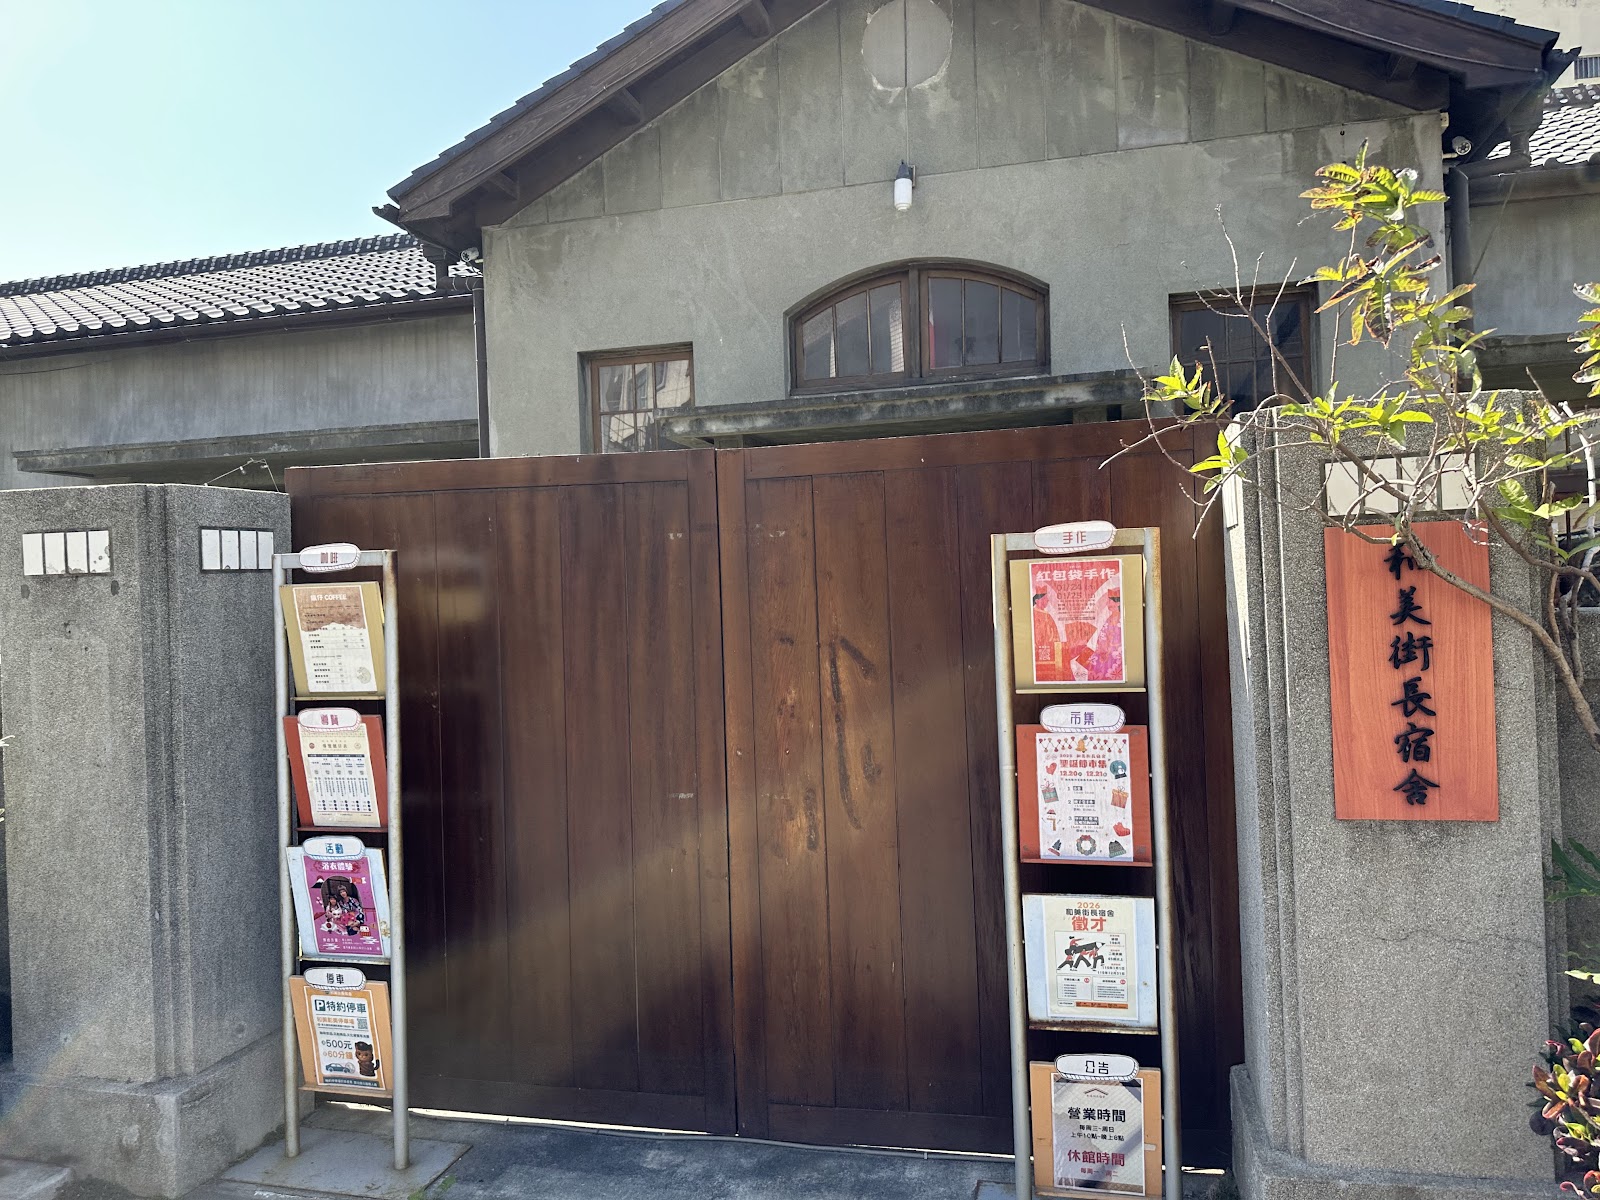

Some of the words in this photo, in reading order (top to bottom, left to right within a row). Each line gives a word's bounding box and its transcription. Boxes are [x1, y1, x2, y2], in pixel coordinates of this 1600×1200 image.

[1062, 530, 1087, 545] 手作
[1036, 567, 1116, 582] 紅包袋手作
[1070, 711, 1095, 726] 市集
[325, 842, 344, 855] 活動
[321, 861, 353, 871] 浴衣體驗
[1066, 908, 1115, 917] 和美街長宿舍
[1077, 901, 1101, 909] 2026
[1071, 915, 1107, 932] 徵才
[326, 972, 345, 985] 停車
[326, 1000, 367, 1013] 特約停車
[1085, 1060, 1109, 1075] 公告
[1067, 1106, 1126, 1123] 營業時間
[1067, 1149, 1125, 1167] 休館時間
